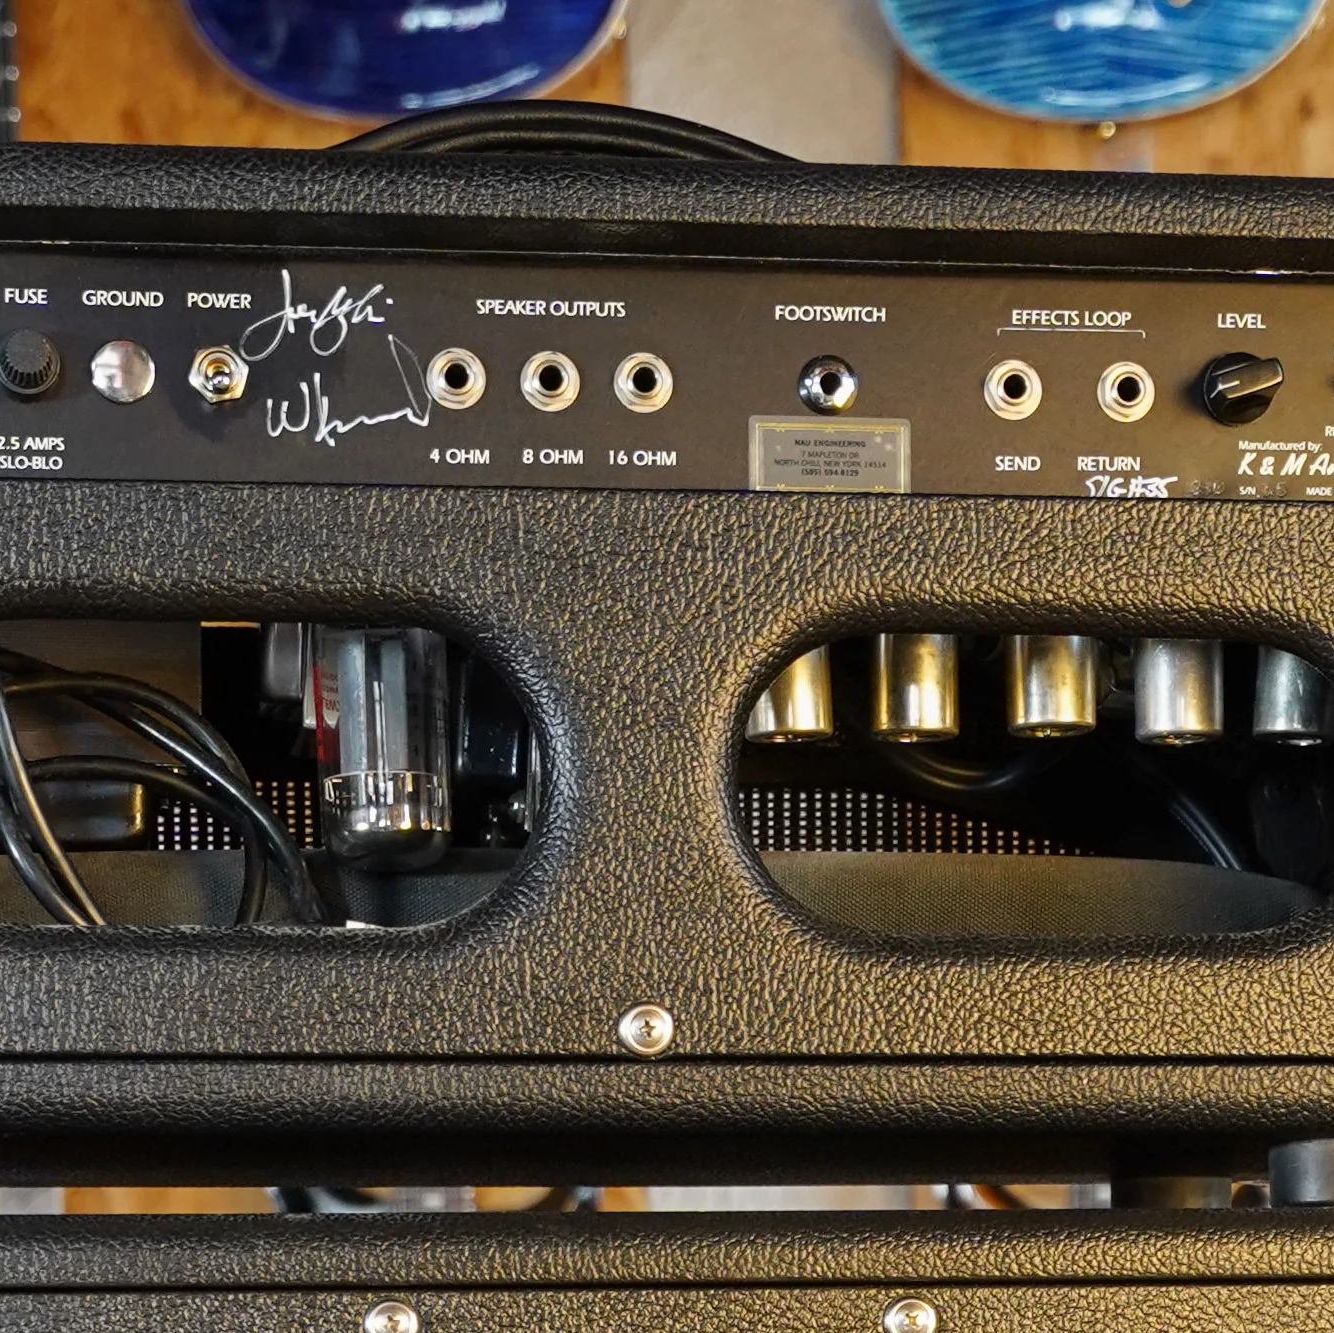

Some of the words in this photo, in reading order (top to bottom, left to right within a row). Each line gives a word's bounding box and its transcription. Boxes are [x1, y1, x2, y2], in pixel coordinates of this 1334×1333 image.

[4, 287, 48, 305] FUSE
[81, 289, 164, 307] GROUND
[187, 292, 252, 309] POWER
[476, 299, 547, 316] SPEAKER
[549, 300, 626, 318] OUTPUTS
[774, 304, 886, 323] FOOTSWITCH
[1011, 309, 1080, 326] EFFECTS
[1084, 310, 1132, 327] LOOP
[1217, 313, 1267, 329] LEVEL
[22, 436, 65, 451] AMPS
[1238, 440, 1305, 451] Manufactured
[1307, 441, 1323, 454] by:
[0, 455, 63, 470] SLO-BLO
[429, 448, 441, 464] 4
[445, 448, 490, 465] OHM
[522, 448, 534, 464] 8
[539, 448, 584, 465] OHM
[609, 449, 629, 465] 16
[632, 450, 677, 466] OHM
[995, 455, 1041, 472] SEND
[1077, 456, 1141, 472] RETURN
[1237, 452, 1257, 476] K
[1259, 456, 1275, 476] &
[1280, 452, 1308, 476] M
[1305, 486, 1333, 497] MADE
